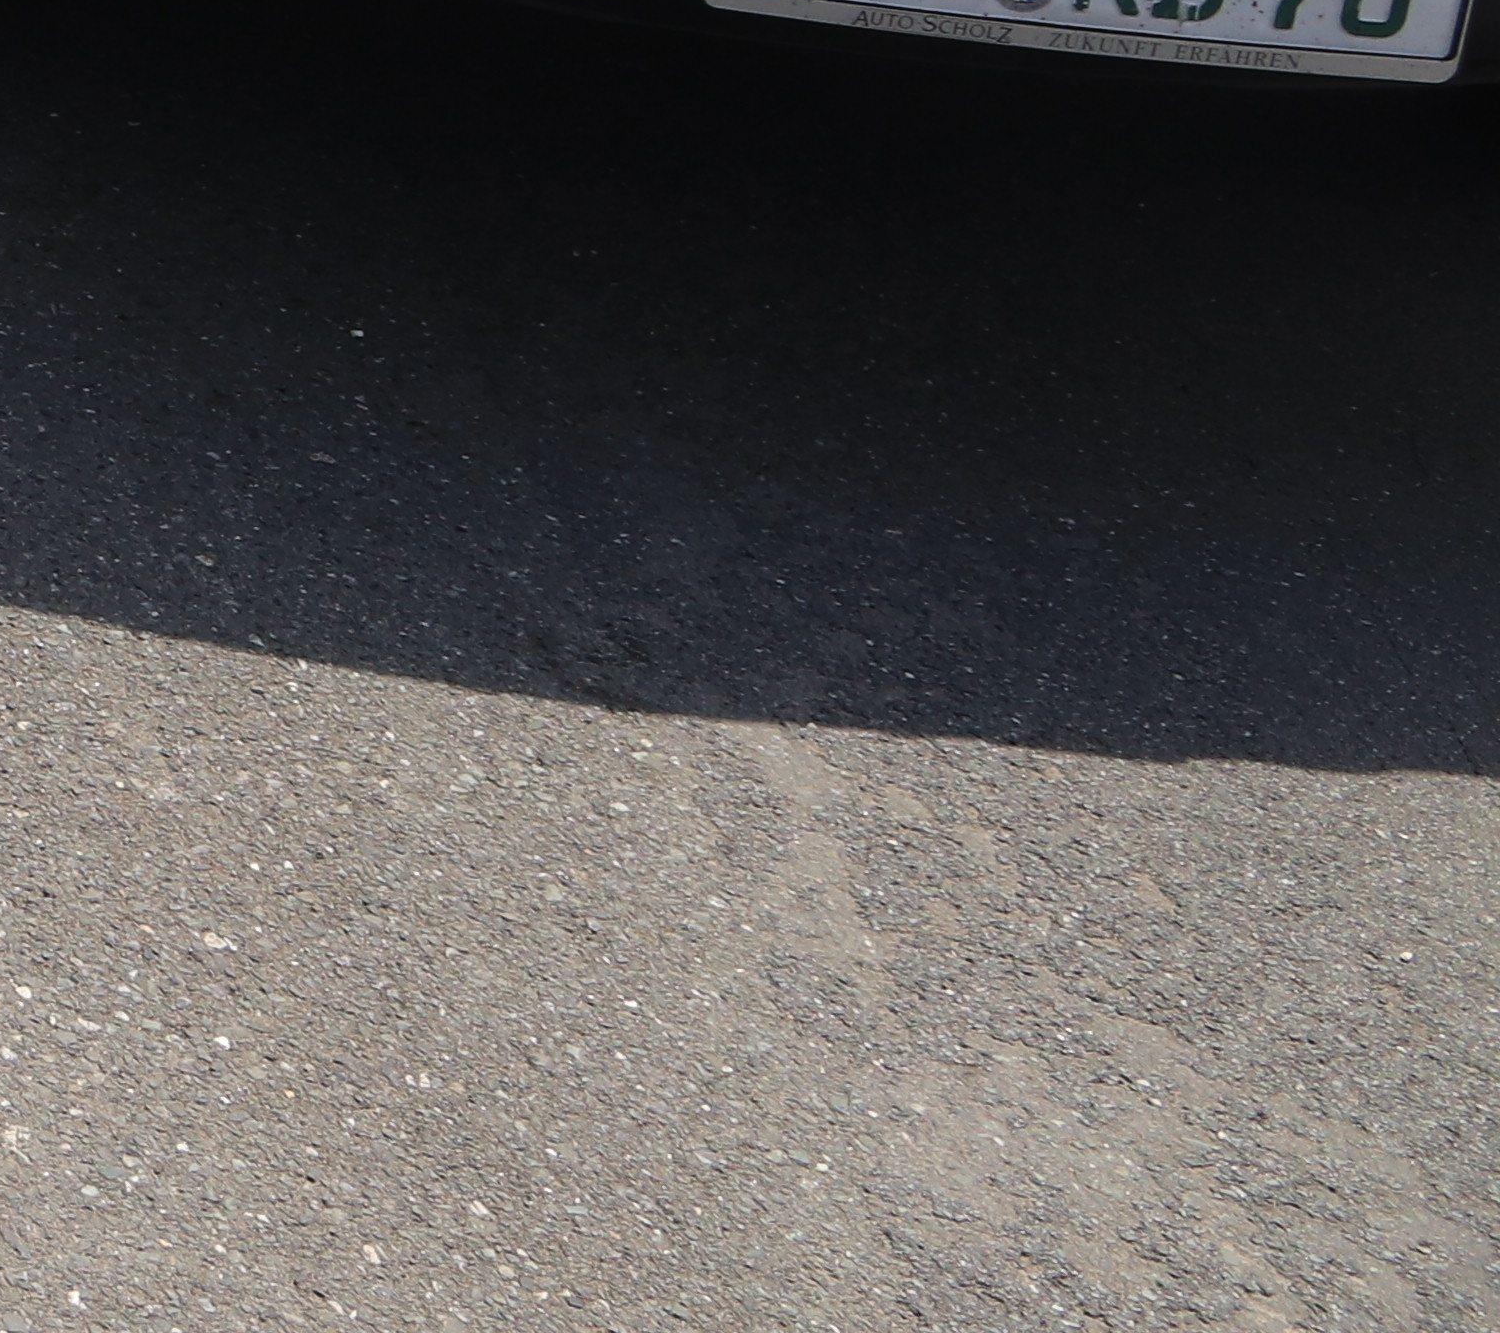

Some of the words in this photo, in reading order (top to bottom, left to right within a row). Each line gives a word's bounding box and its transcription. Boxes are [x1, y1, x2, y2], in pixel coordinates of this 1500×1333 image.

[851, 9, 914, 31] AUTO
[921, 13, 1013, 46] SCHOLZ
[1049, 30, 1161, 59] ZUKUNFT
[1174, 42, 1301, 71] ERFAHREN
